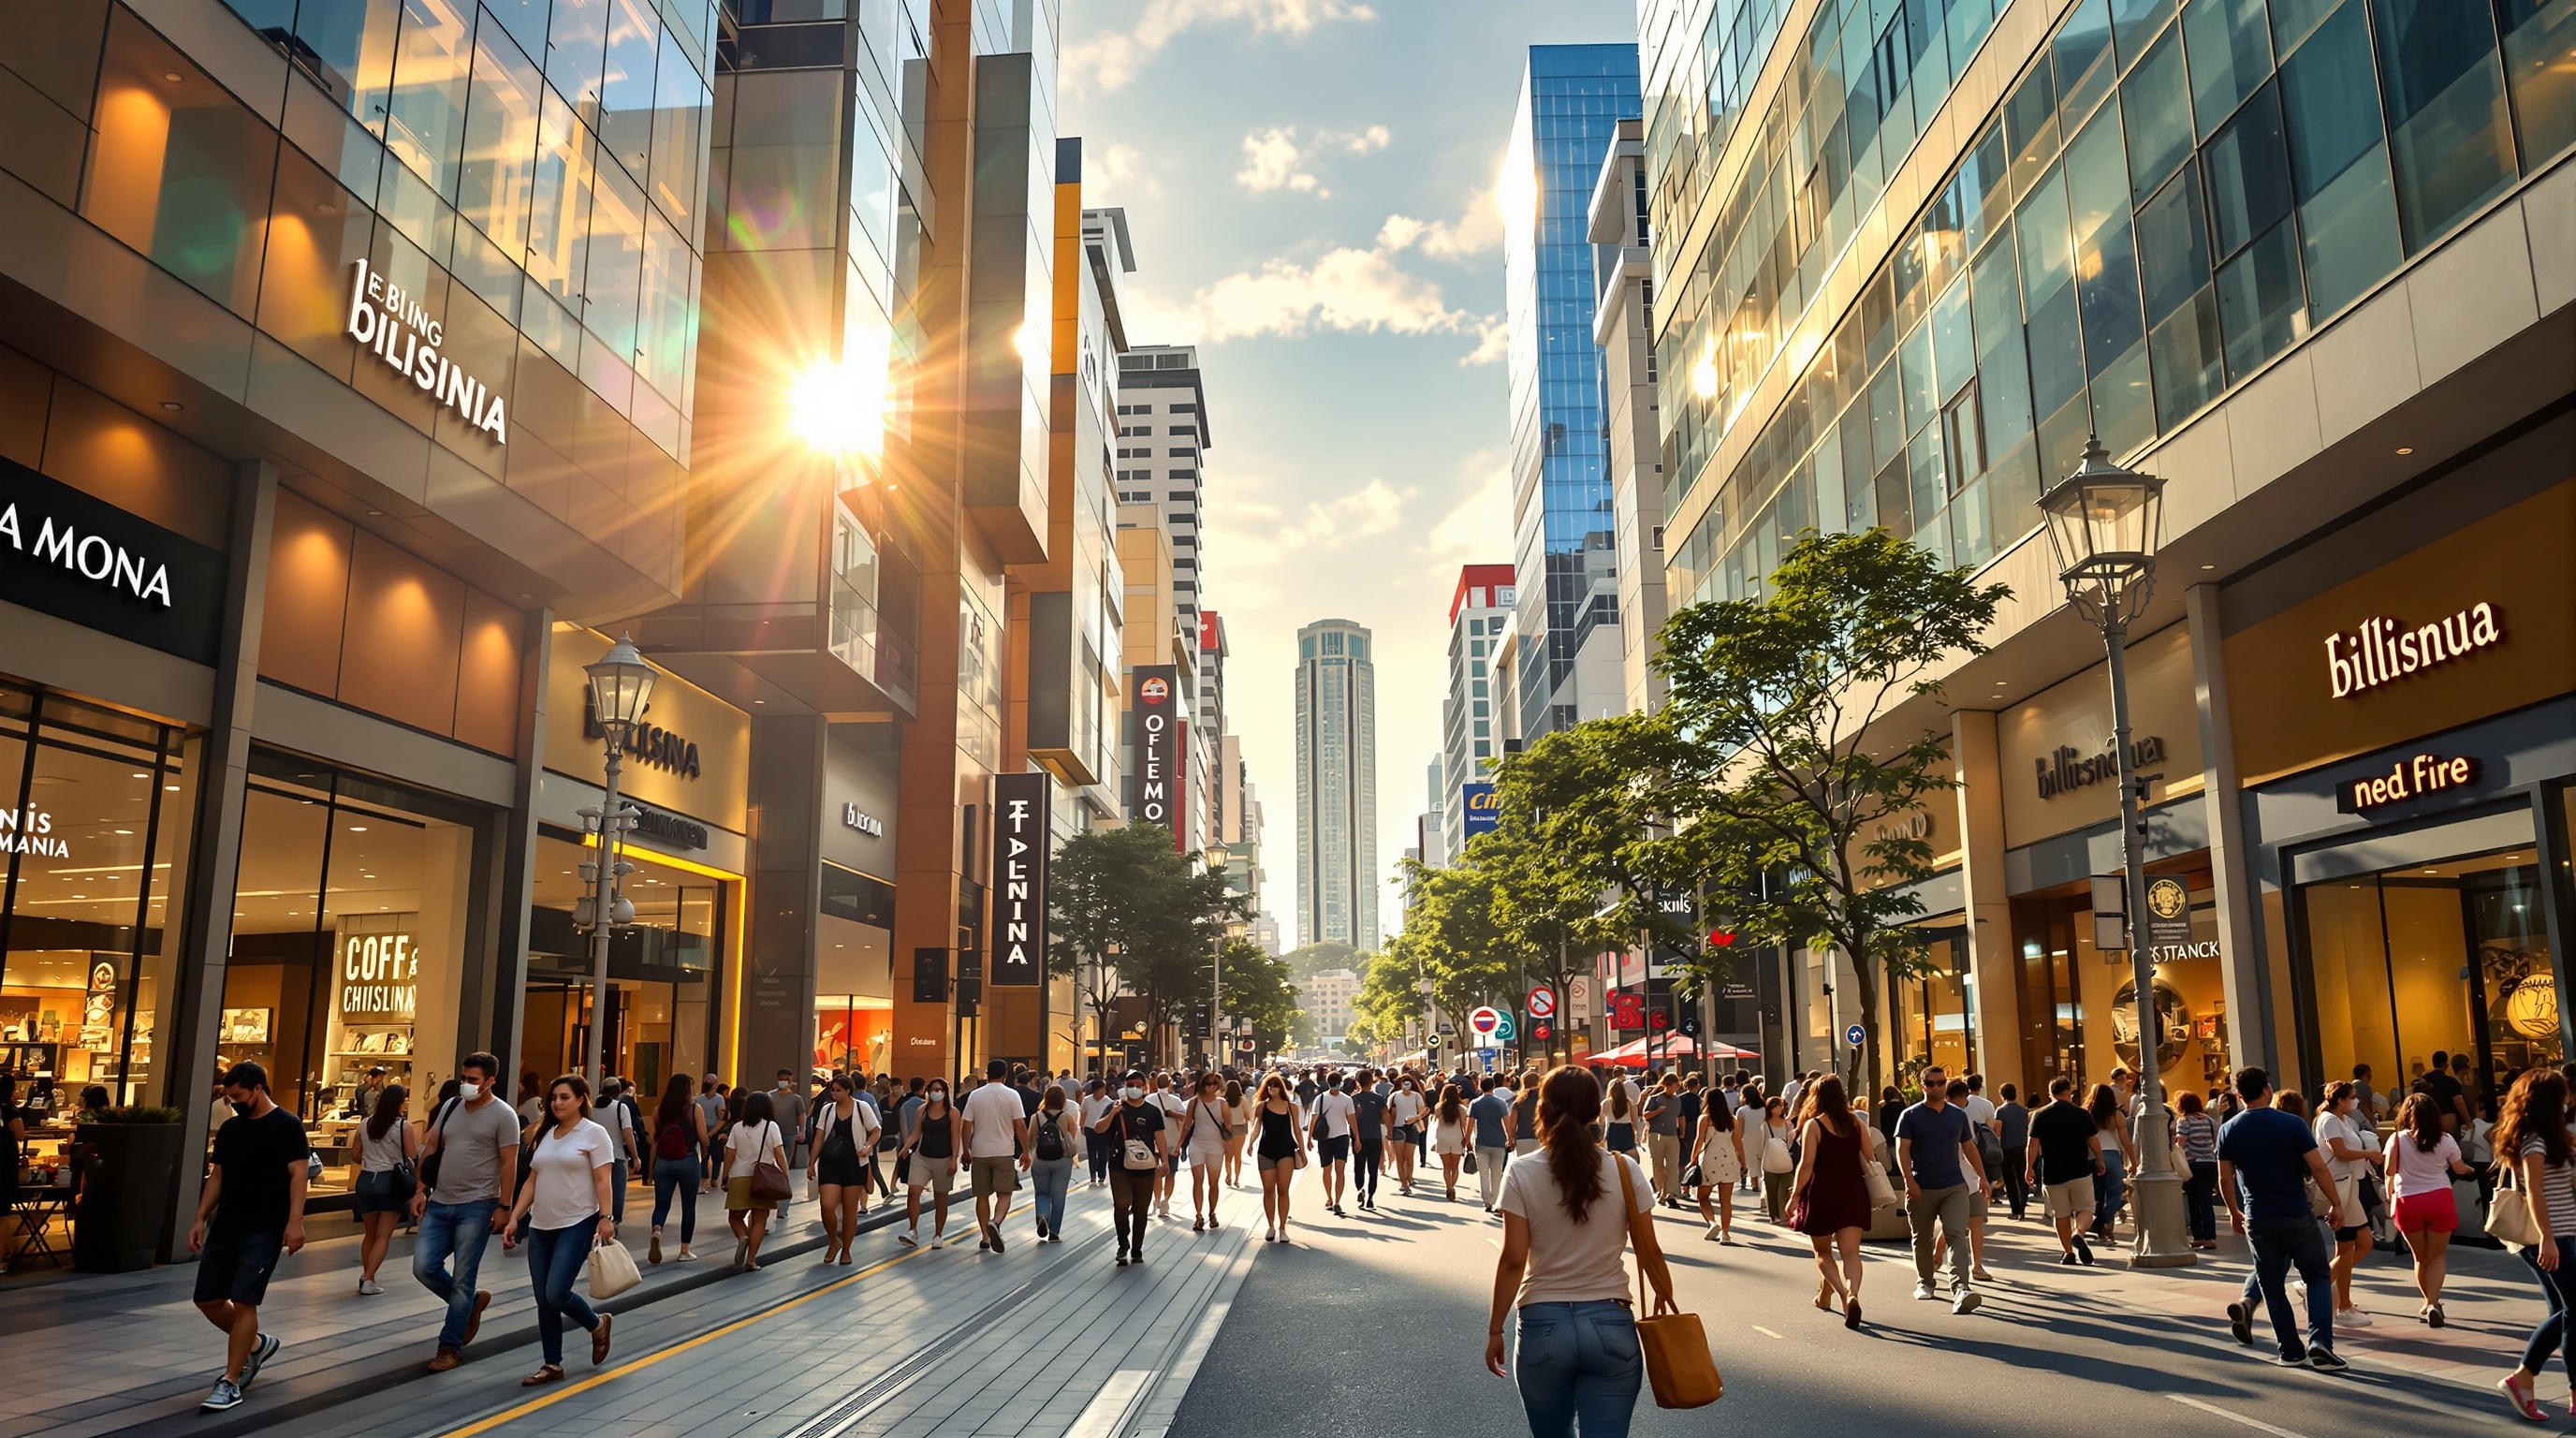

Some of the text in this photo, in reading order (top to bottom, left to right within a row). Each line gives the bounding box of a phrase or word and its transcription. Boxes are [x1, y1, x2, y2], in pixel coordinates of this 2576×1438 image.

[32, 516, 171, 608] MONA
[2324, 602, 2499, 698] billisnua
[2354, 763, 2408, 808] ned
